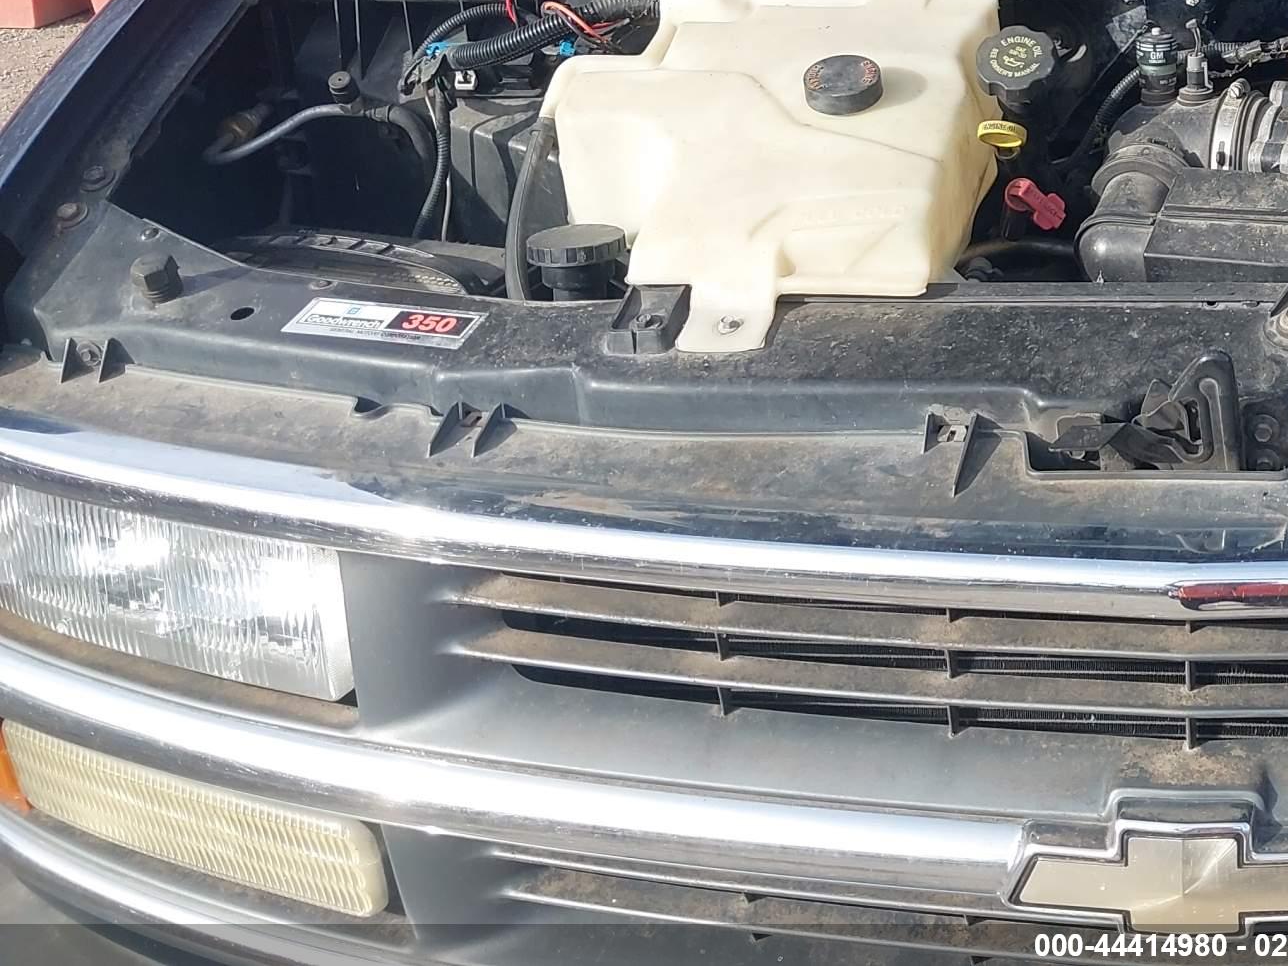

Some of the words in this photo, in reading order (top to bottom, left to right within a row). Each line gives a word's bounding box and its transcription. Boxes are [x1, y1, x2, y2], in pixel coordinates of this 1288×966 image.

[1000, 36, 1037, 47] ENGINE
[1032, 45, 1044, 58] OIL
[1150, 51, 1164, 59] GM
[1014, 62, 1041, 78] MANUAL
[303, 314, 380, 329] Goodwrench
[401, 314, 458, 333] 350
